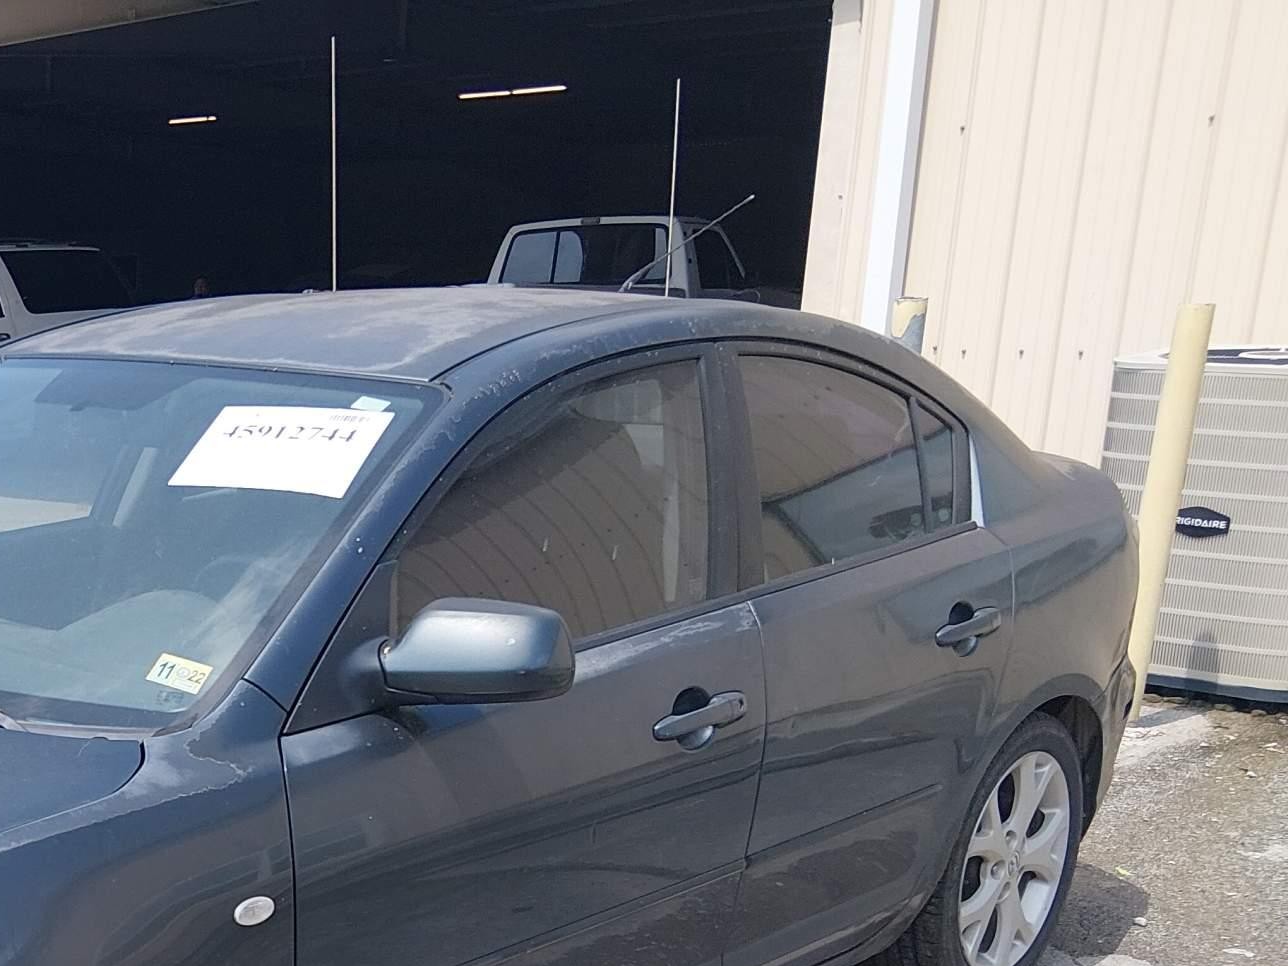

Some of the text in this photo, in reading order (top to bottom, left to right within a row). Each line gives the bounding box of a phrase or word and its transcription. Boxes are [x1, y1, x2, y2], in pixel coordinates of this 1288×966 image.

[224, 425, 357, 442] 45912744
[1176, 516, 1228, 529] RIGIDAIRE
[157, 662, 206, 684] 11 22
